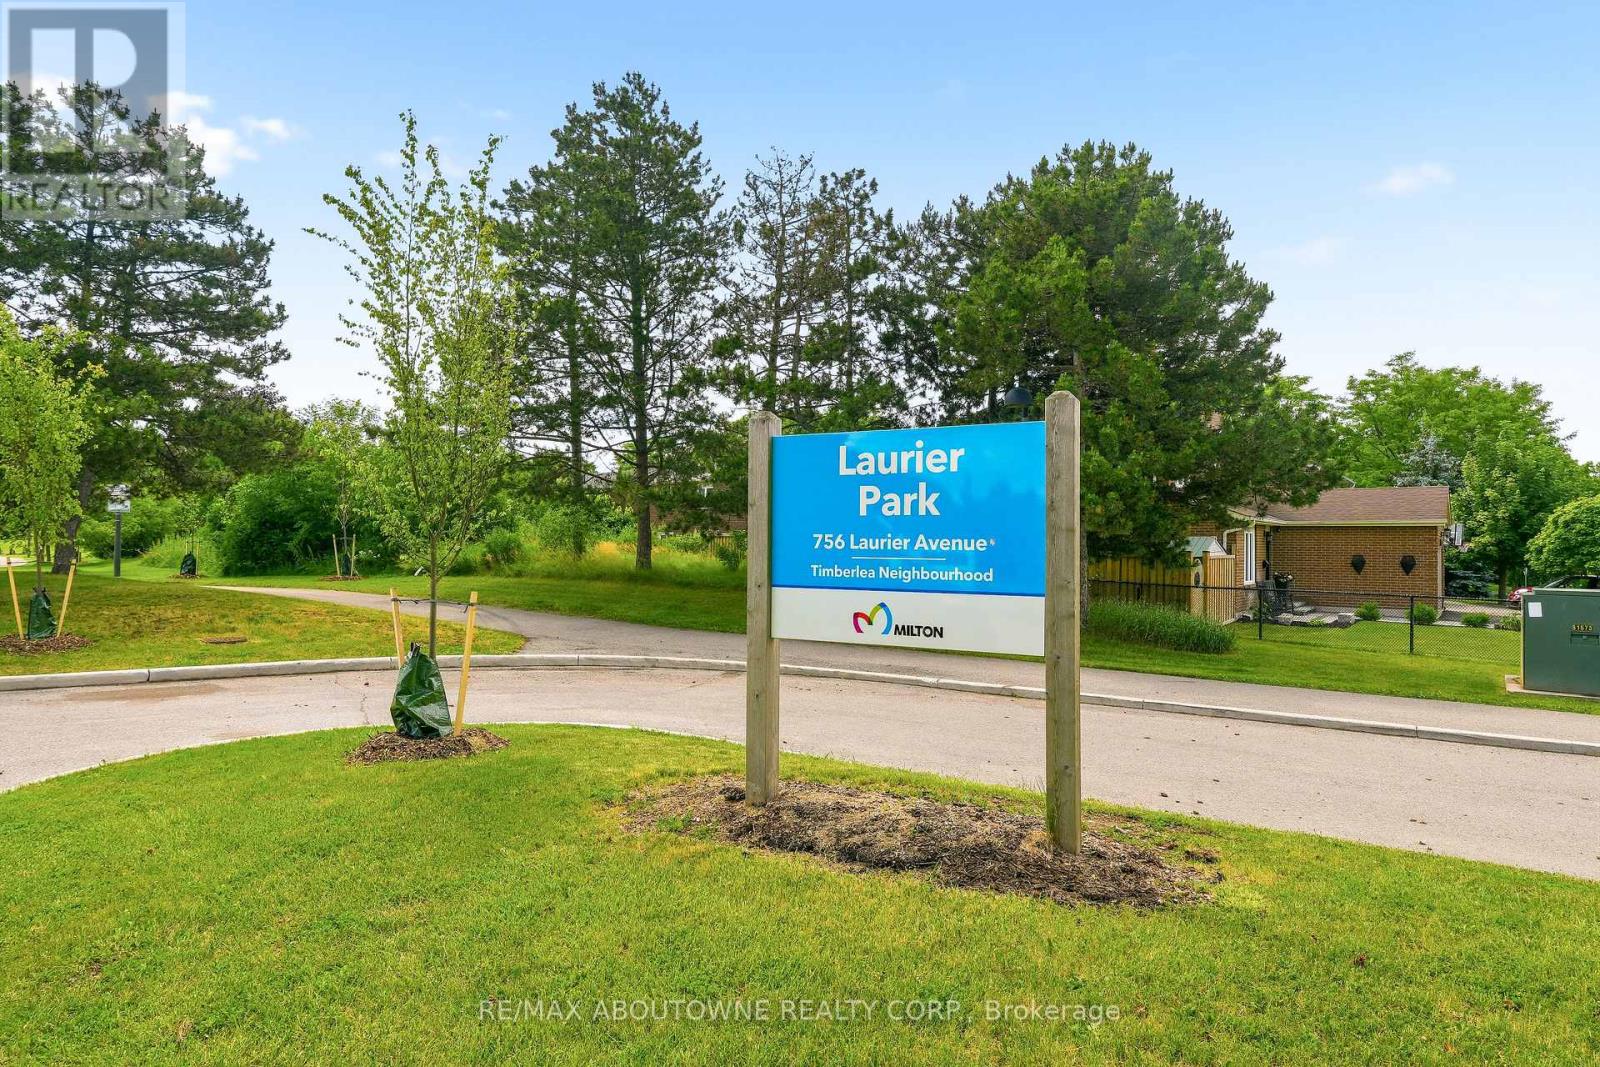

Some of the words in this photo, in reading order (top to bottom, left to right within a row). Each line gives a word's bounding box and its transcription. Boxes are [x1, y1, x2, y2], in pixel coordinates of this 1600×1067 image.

[838, 440, 966, 476] Laurier
[858, 482, 941, 516] Park
[812, 534, 846, 550] 756
[849, 533, 911, 551] Laurier
[913, 534, 988, 552] Avenue
[810, 564, 876, 579] Timberlea
[879, 566, 994, 583] Neighbourhood
[893, 624, 944, 639] MILTON
